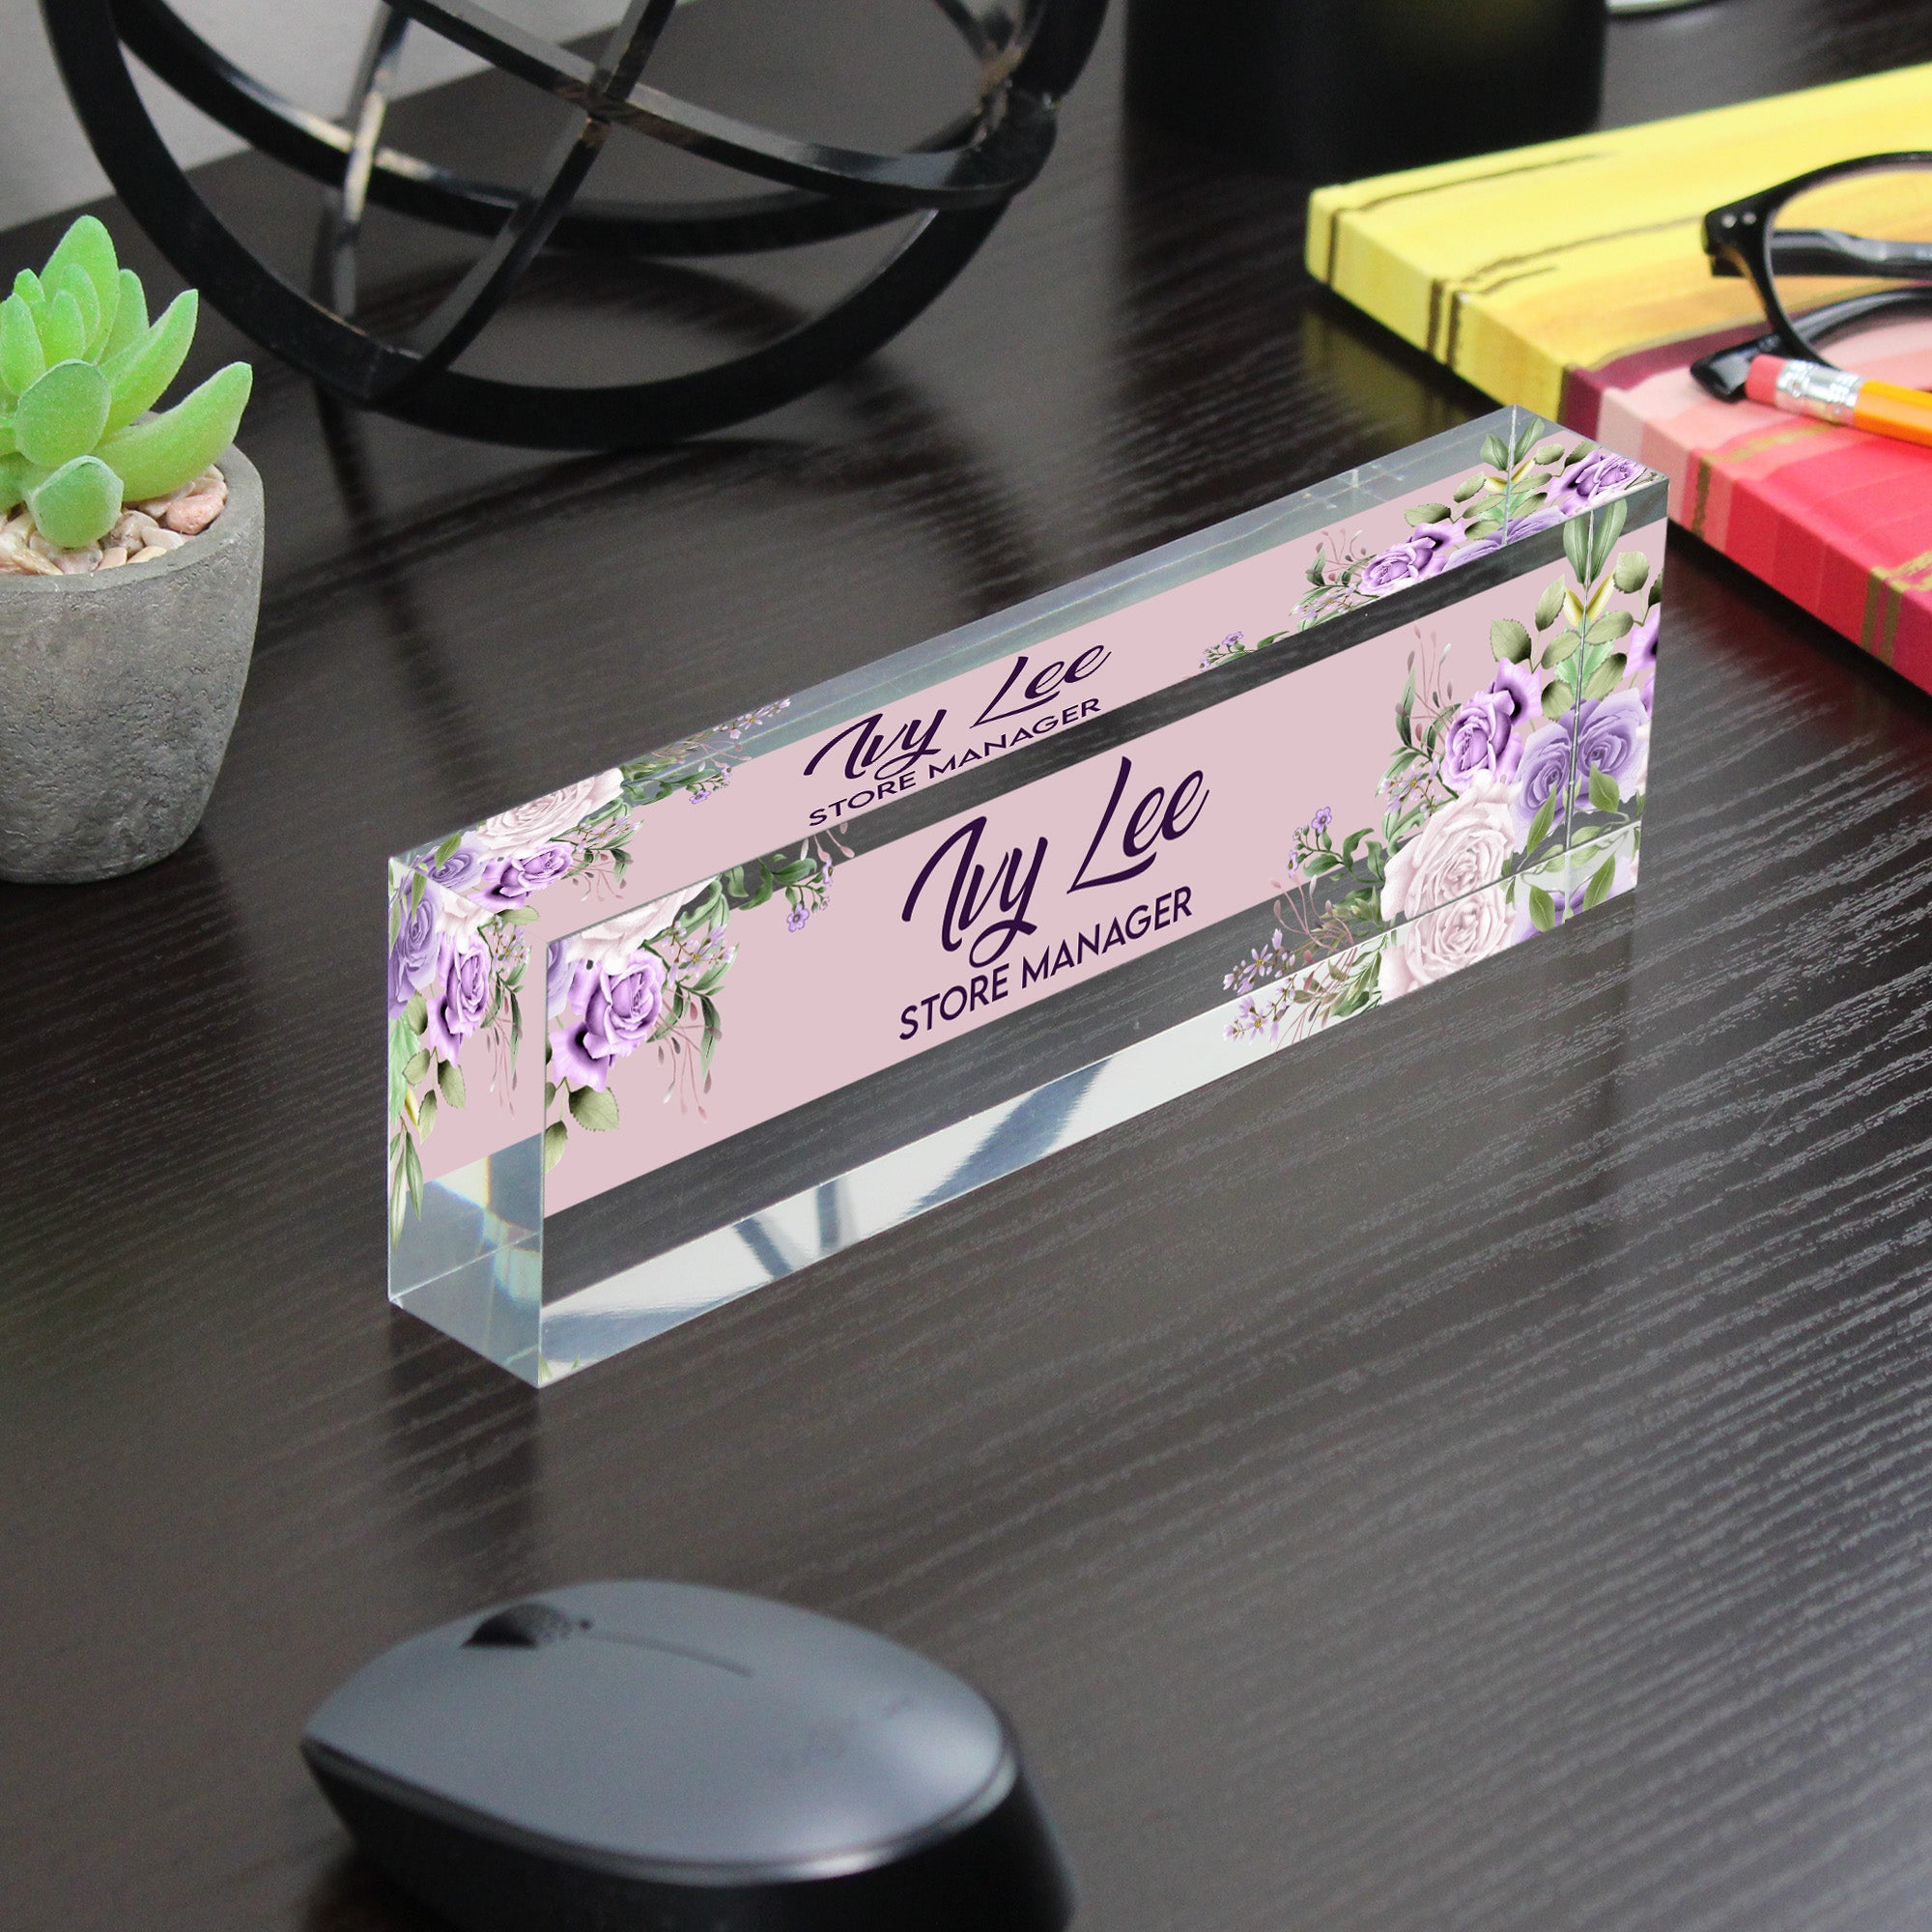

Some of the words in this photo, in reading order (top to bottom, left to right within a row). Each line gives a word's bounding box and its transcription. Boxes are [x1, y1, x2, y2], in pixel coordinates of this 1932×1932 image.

[803, 708, 948, 781] Ivy
[969, 644, 1112, 729] Lee
[809, 772, 917, 827] STORE
[927, 697, 1101, 780] MANAGER
[900, 815, 1049, 969] Ivy
[1065, 755, 1210, 895] Lee
[898, 962, 1010, 1041] STORE
[1020, 885, 1193, 990] MANAGER
